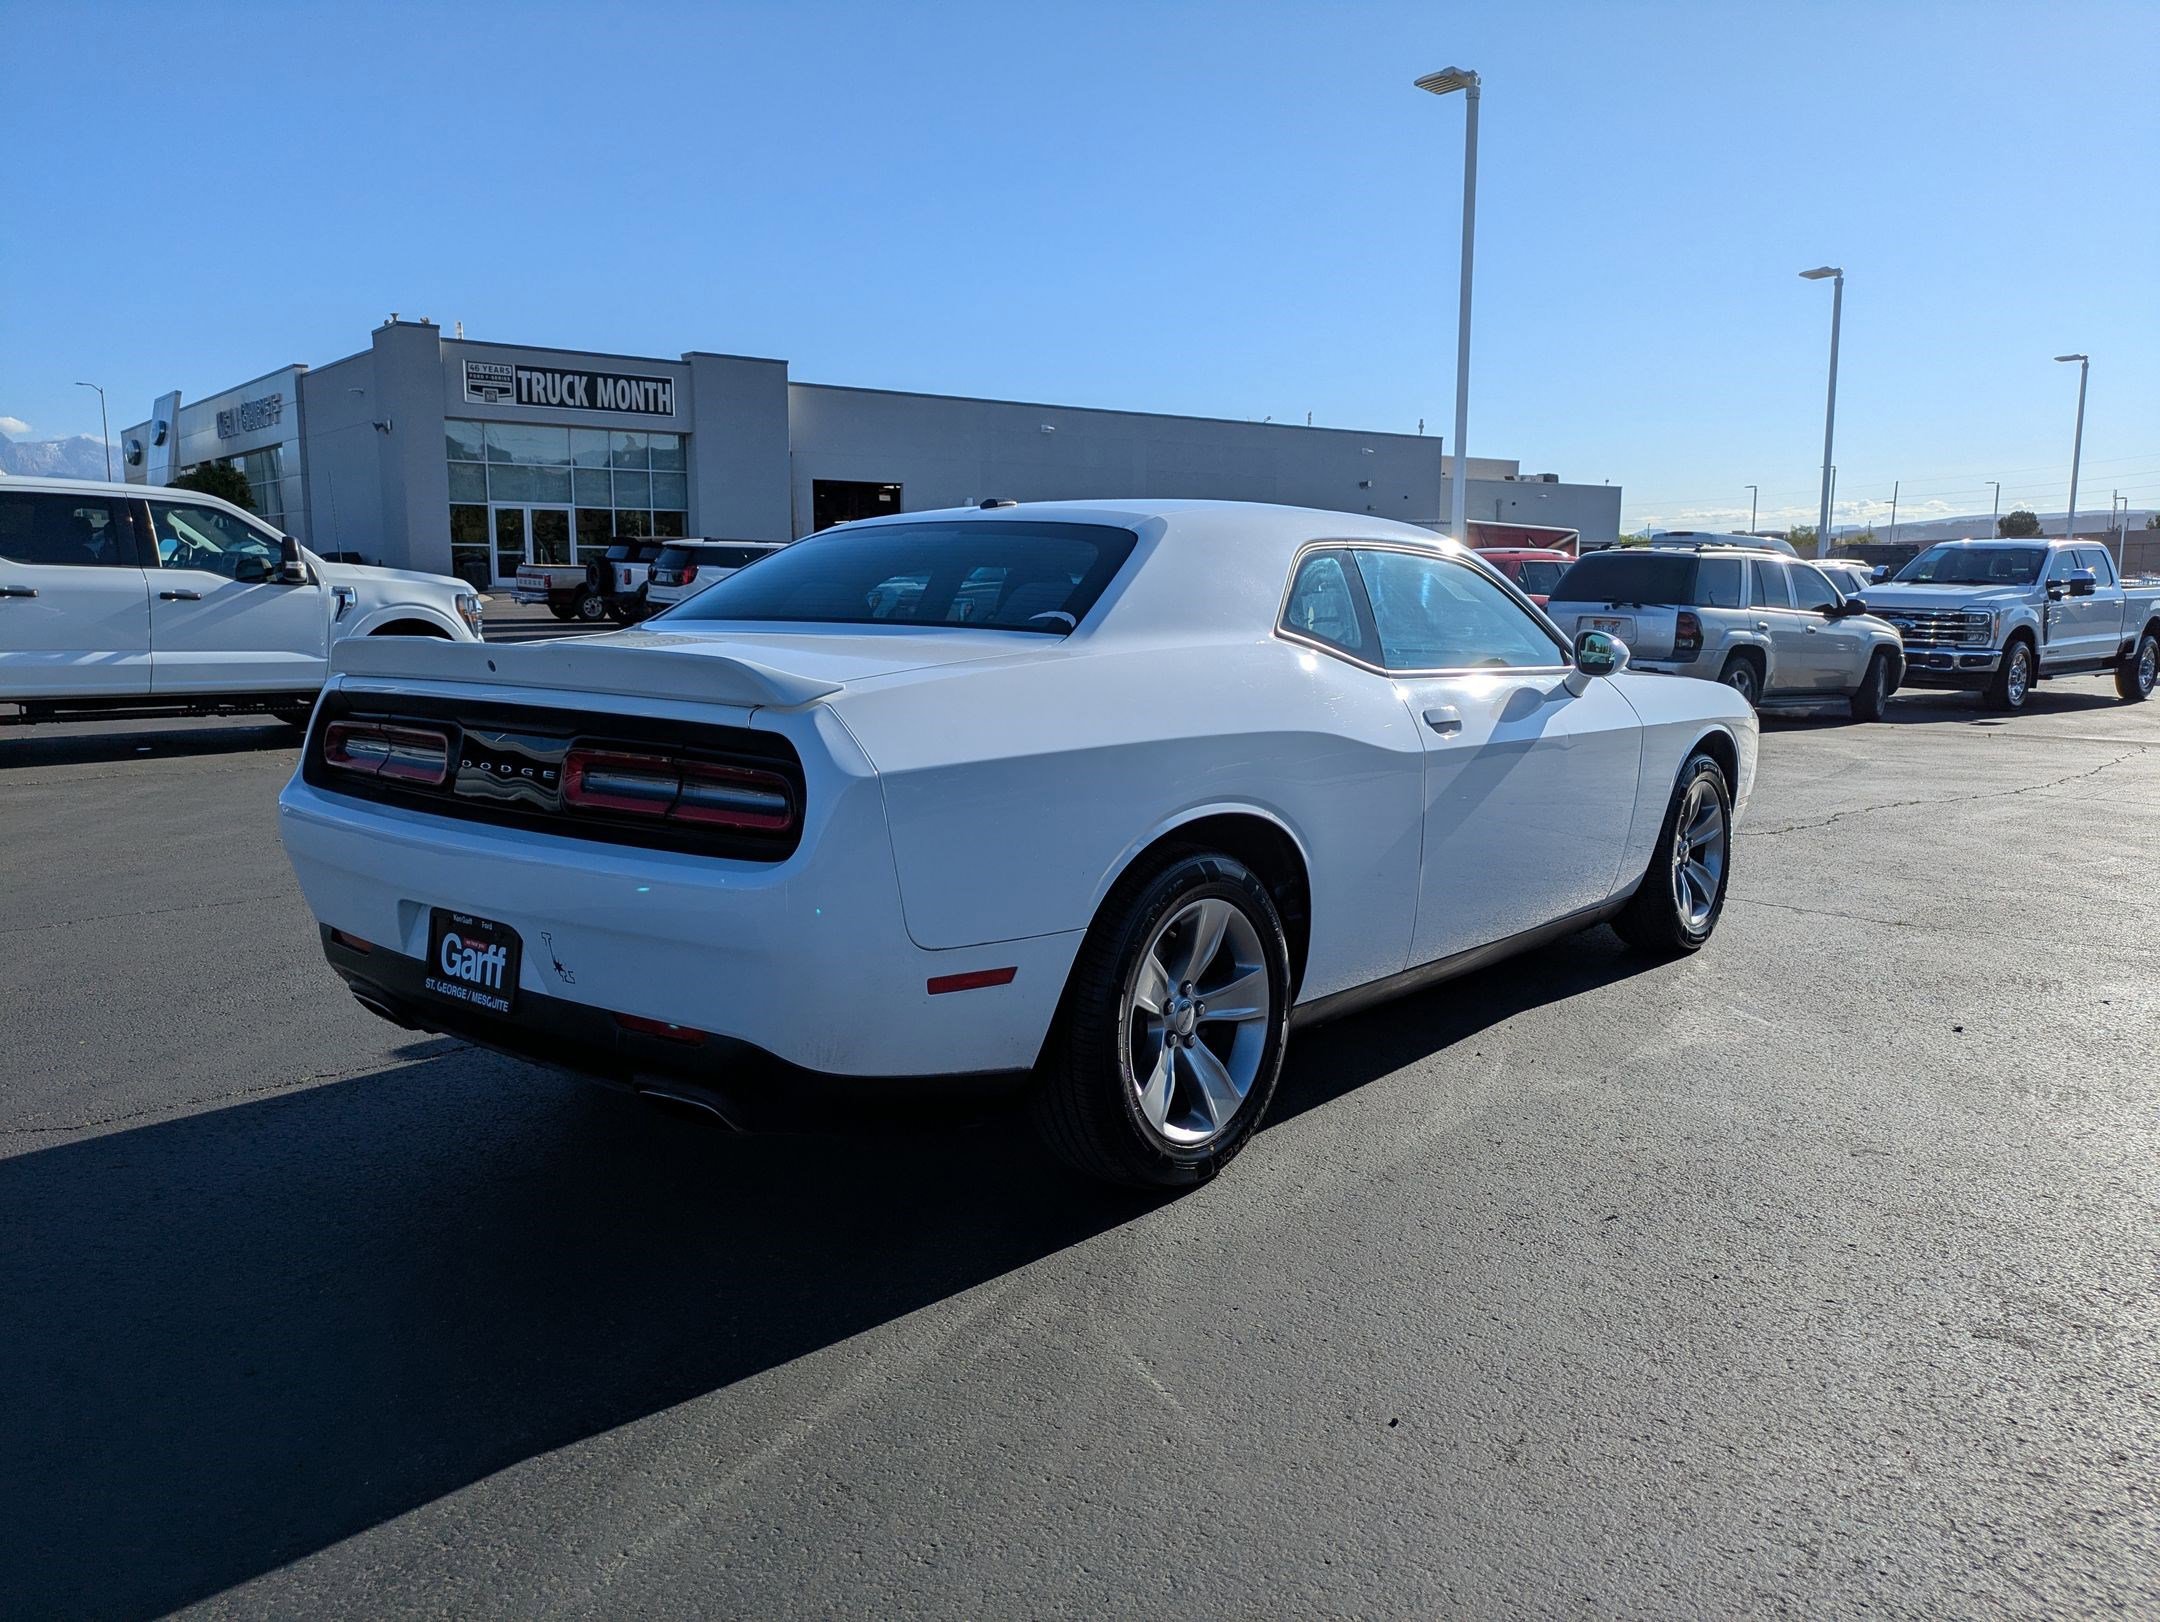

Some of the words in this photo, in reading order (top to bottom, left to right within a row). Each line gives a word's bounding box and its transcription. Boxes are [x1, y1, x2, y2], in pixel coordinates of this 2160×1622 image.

[469, 364, 480, 372] 46
[482, 365, 511, 375] YEARS
[517, 370, 589, 407] TRUCK
[597, 377, 672, 413] MONTH
[461, 759, 556, 779] DODGE
[441, 932, 506, 989] Garff
[425, 977, 436, 990] ST.
[437, 981, 468, 999] GEORGE
[472, 991, 509, 1013] MESQUITE
